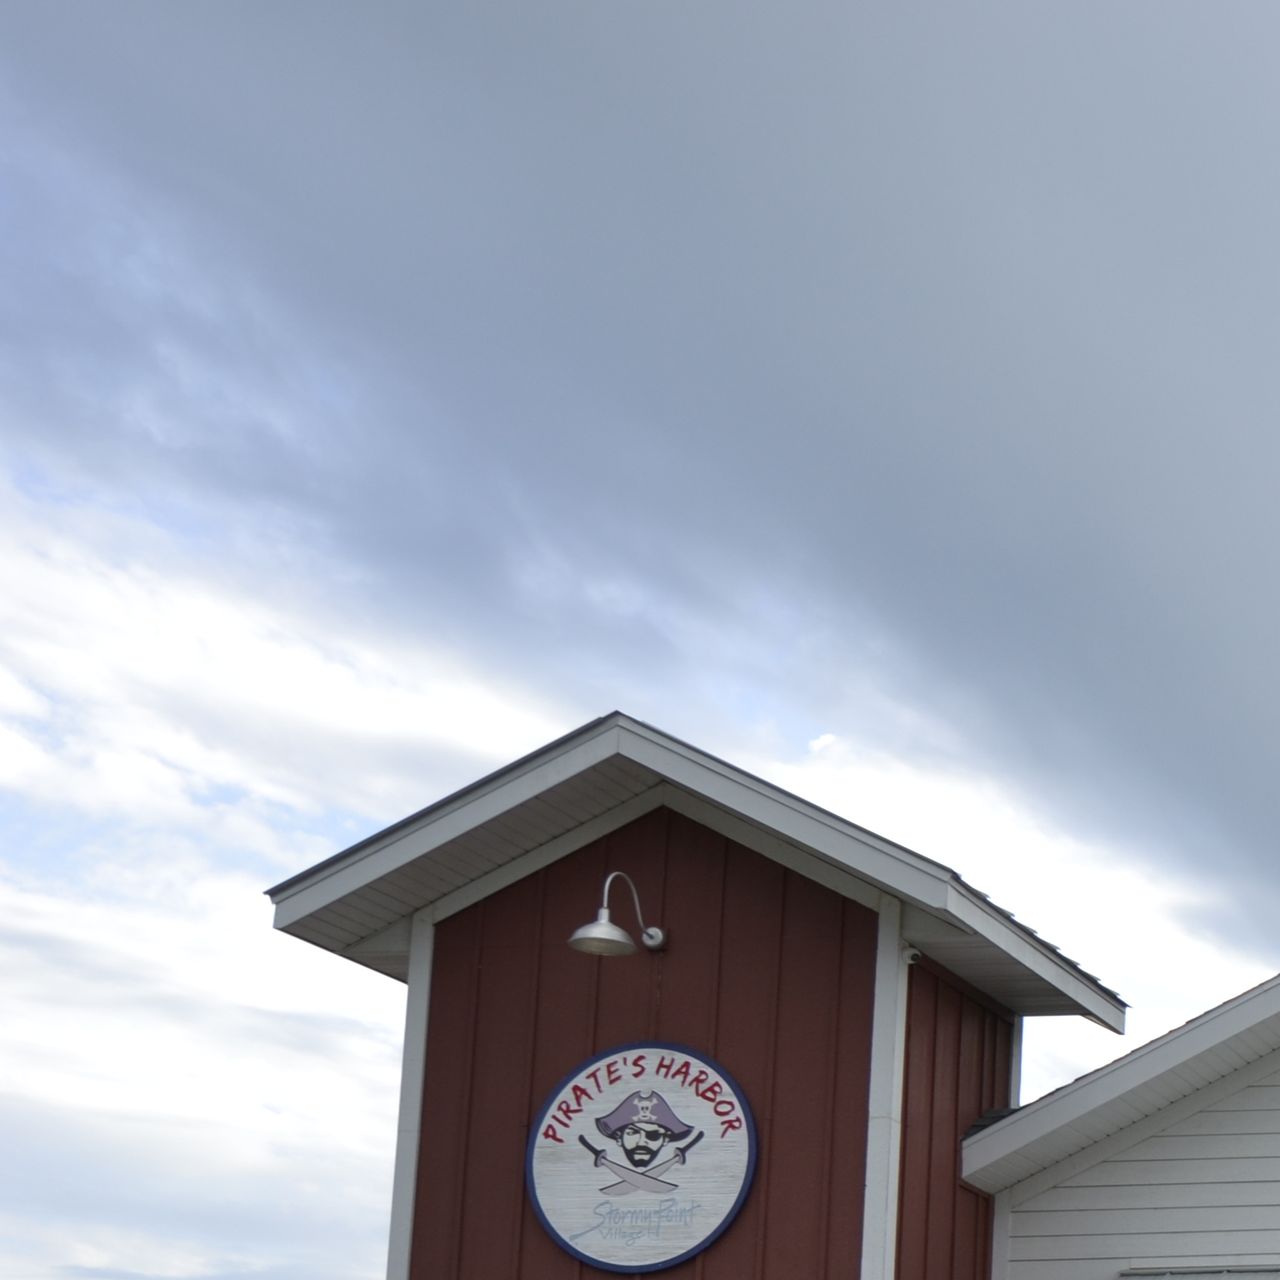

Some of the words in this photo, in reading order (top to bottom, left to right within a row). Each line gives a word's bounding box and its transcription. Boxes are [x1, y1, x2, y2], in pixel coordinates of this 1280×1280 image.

[542, 1054, 647, 1144] PIRATE'S
[655, 1054, 743, 1139] HARBOR
[599, 1227, 647, 1247] Village
[654, 1198, 702, 1238] Point
